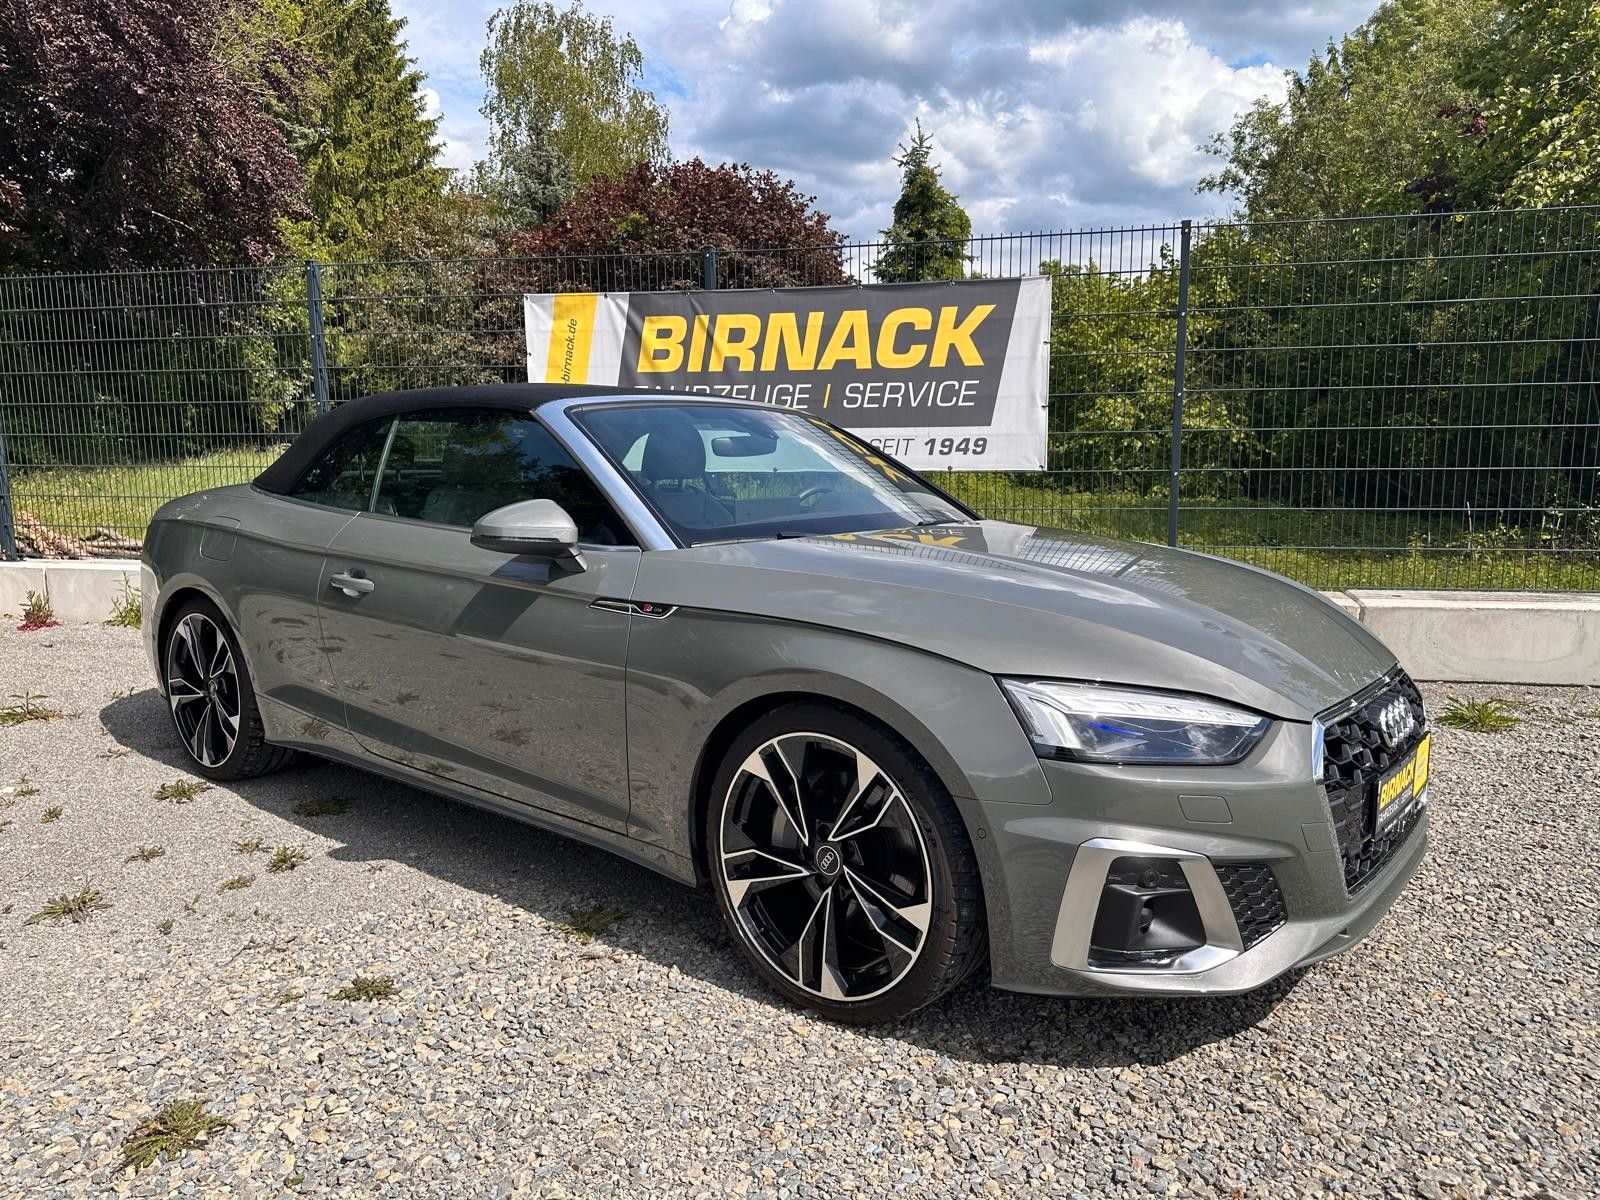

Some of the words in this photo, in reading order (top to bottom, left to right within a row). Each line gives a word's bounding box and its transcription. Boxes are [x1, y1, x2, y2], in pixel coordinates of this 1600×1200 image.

[636, 304, 997, 373] BIRNACK
[843, 380, 980, 408] SERVICE
[924, 437, 988, 456] 1949
